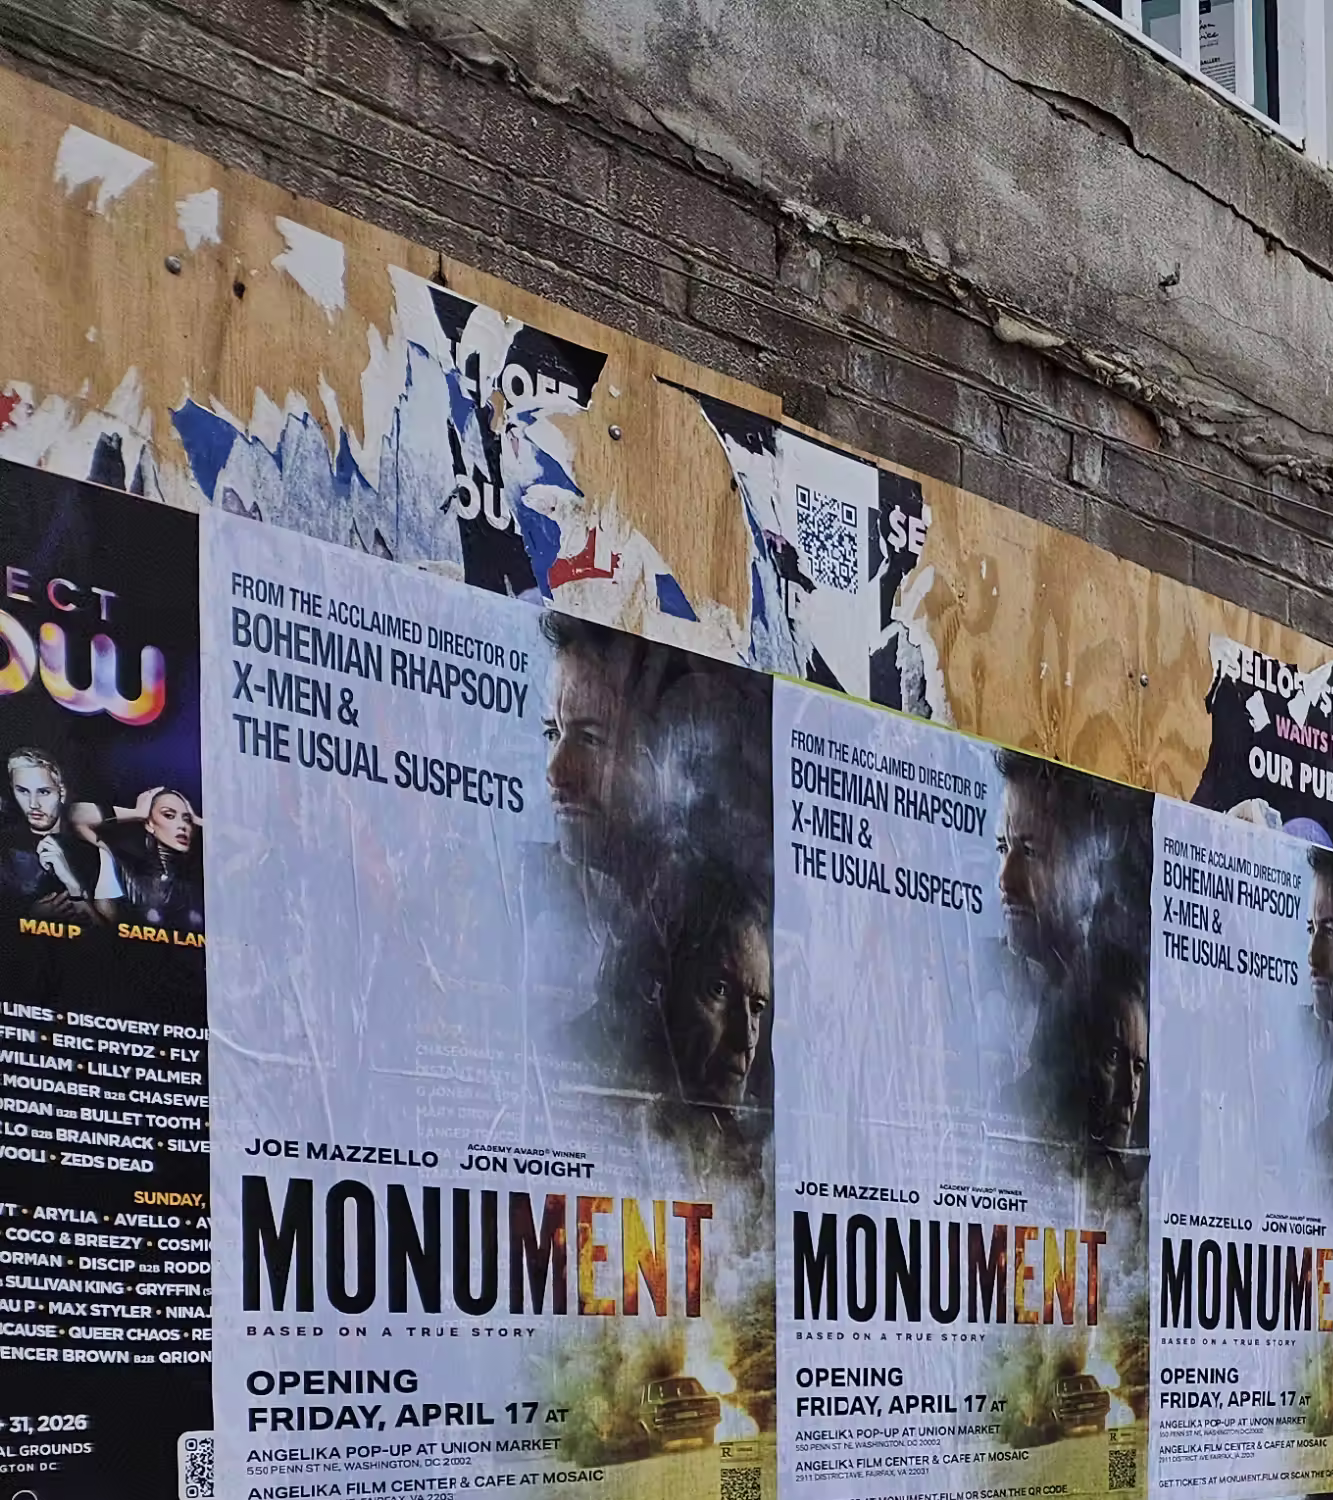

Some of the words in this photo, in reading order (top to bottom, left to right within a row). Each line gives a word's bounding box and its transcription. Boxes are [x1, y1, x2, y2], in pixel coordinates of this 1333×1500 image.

[231, 571, 285, 609] FROM
[289, 588, 322, 619] THE
[327, 598, 422, 646] ACCLAIMED
[427, 626, 503, 668] DIRECTOR
[509, 648, 528, 674] OF
[232, 606, 382, 682] BOHEMIAN
[390, 648, 528, 719] RHAPSODY
[232, 659, 331, 721] X-MEN
[337, 685, 359, 728] &
[1275, 714, 1328, 753] WANTS
[233, 713, 289, 764] THE
[297, 727, 387, 785] USUAL
[394, 750, 523, 814] SUSPECTS
[1249, 746, 1293, 789] OUR
[20, 919, 64, 938] MAU
[69, 926, 81, 939] P
[118, 923, 168, 943] SARA
[4, 1002, 53, 1021] LINES
[67, 1012, 160, 1037] DISCOVERY
[52, 1034, 94, 1051] ERIC
[98, 1039, 155, 1059] PRYDZ
[170, 1048, 200, 1062] FLY
[88, 1062, 131, 1079] LILLY
[136, 1067, 202, 1086] PALMER
[3, 1074, 100, 1098] MOUDABER
[104, 1091, 125, 1101] B2B
[56, 1129, 153, 1150] BRAINRACK
[61, 1152, 104, 1168] ZEDS
[108, 1157, 153, 1173] DEAD
[244, 1137, 298, 1159] JOE
[305, 1142, 438, 1169] MAZZELLO
[459, 1153, 508, 1173] JON
[516, 1157, 594, 1179] VOIGHT
[134, 1190, 206, 1209] SUNDAY,
[794, 1182, 829, 1199] JOE
[834, 1184, 921, 1205] MAZZELLO
[33, 1206, 98, 1224] ARYLIA
[114, 1213, 180, 1229] AVELLO
[5, 1228, 55, 1244] COCO
[59, 1232, 71, 1245] &
[74, 1232, 143, 1250] BREEZY
[241, 1173, 713, 1318] MONUMENT
[792, 1210, 1106, 1326] MONUMENT
[5, 1275, 82, 1293] SULLIVAN
[84, 1279, 124, 1295] KING
[135, 1282, 200, 1297] GRYFFIN
[247, 1326, 320, 1336] BASED
[339, 1326, 367, 1336] ON
[381, 1327, 392, 1337] A
[406, 1327, 459, 1337] TRUE
[472, 1327, 535, 1337] STORY
[246, 1368, 418, 1397] OPENING
[793, 1367, 905, 1389] OPENING
[1159, 1367, 1239, 1385] OPENING
[37, 1414, 89, 1433] 2026
[247, 1405, 385, 1436] FRIDAY,
[395, 1402, 494, 1428] APRIL
[505, 1402, 538, 1424] 17
[544, 1408, 569, 1423] AT
[246, 1446, 340, 1464] ANGELIKA
[346, 1442, 411, 1459] POP-UP
[417, 1442, 437, 1456] AT
[443, 1439, 491, 1455] UNION
[495, 1437, 561, 1453] MARKET
